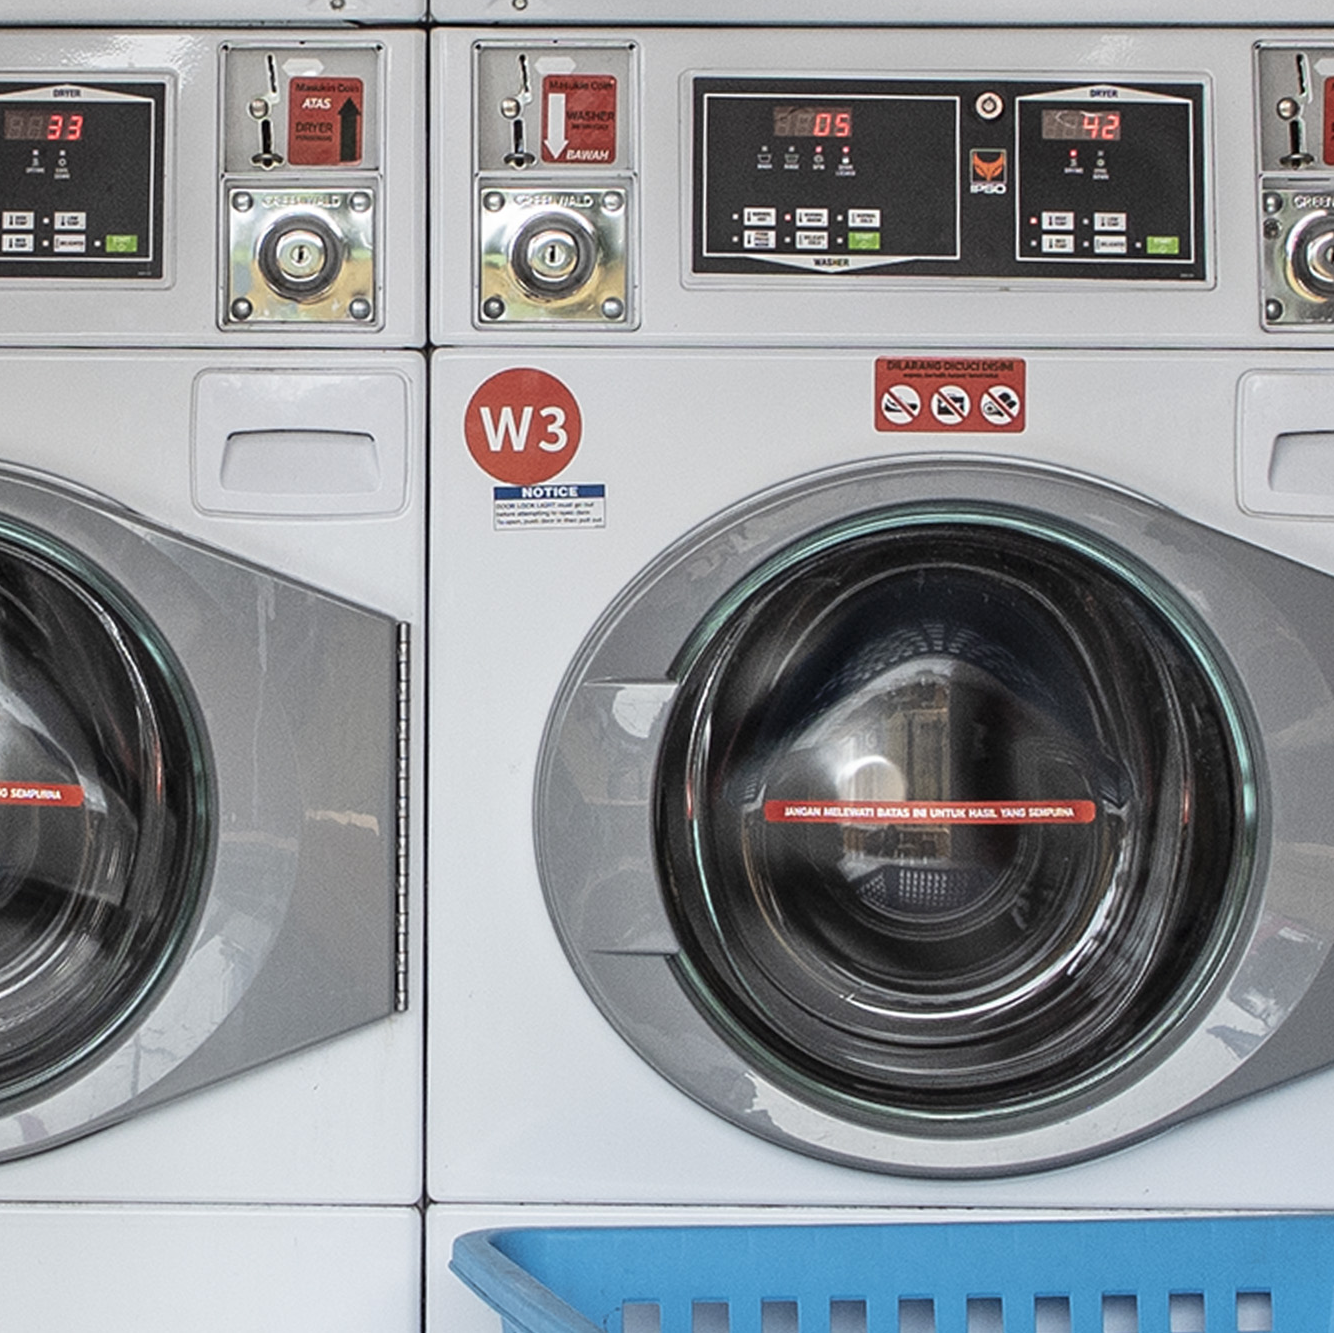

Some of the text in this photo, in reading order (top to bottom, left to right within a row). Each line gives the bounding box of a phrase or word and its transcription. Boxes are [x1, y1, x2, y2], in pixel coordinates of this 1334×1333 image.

[1089, 89, 1119, 99] DRYER
[301, 96, 334, 110] ATAS
[48, 115, 84, 140] 33
[1083, 115, 1121, 140] 42
[813, 257, 851, 267] WASHER
[478, 406, 570, 453] W3
[521, 486, 579, 498] NOTICE
[784, 806, 821, 819] JANGAN
[823, 806, 874, 819] MELEWATI
[876, 806, 910, 819] BATAS
[930, 806, 966, 819] UNTUK
[968, 806, 997, 819] HASIL
[1001, 806, 1026, 819] YANG
